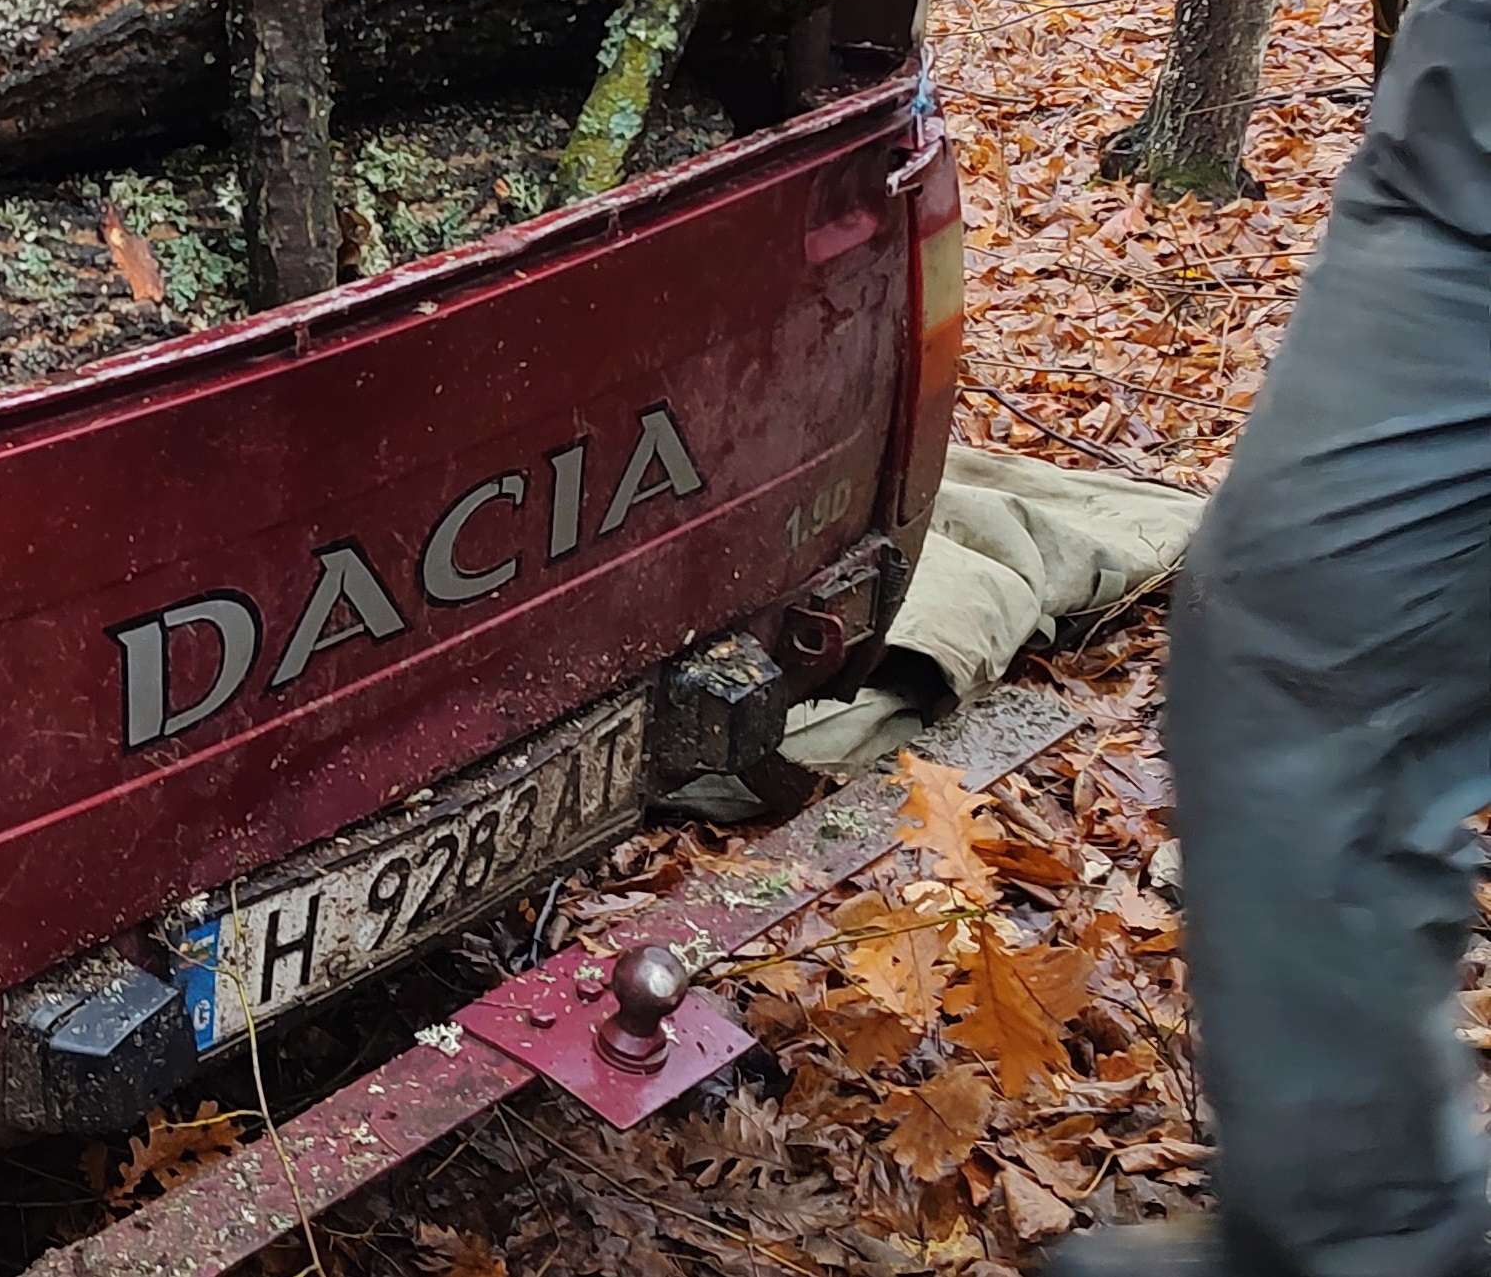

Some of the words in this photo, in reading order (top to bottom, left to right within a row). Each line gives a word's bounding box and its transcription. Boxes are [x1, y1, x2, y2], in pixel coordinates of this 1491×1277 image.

[108, 404, 702, 750] DACIA
[785, 479, 851, 548] 1.9D
[259, 888, 320, 1005] H
[366, 782, 542, 952] 9283
